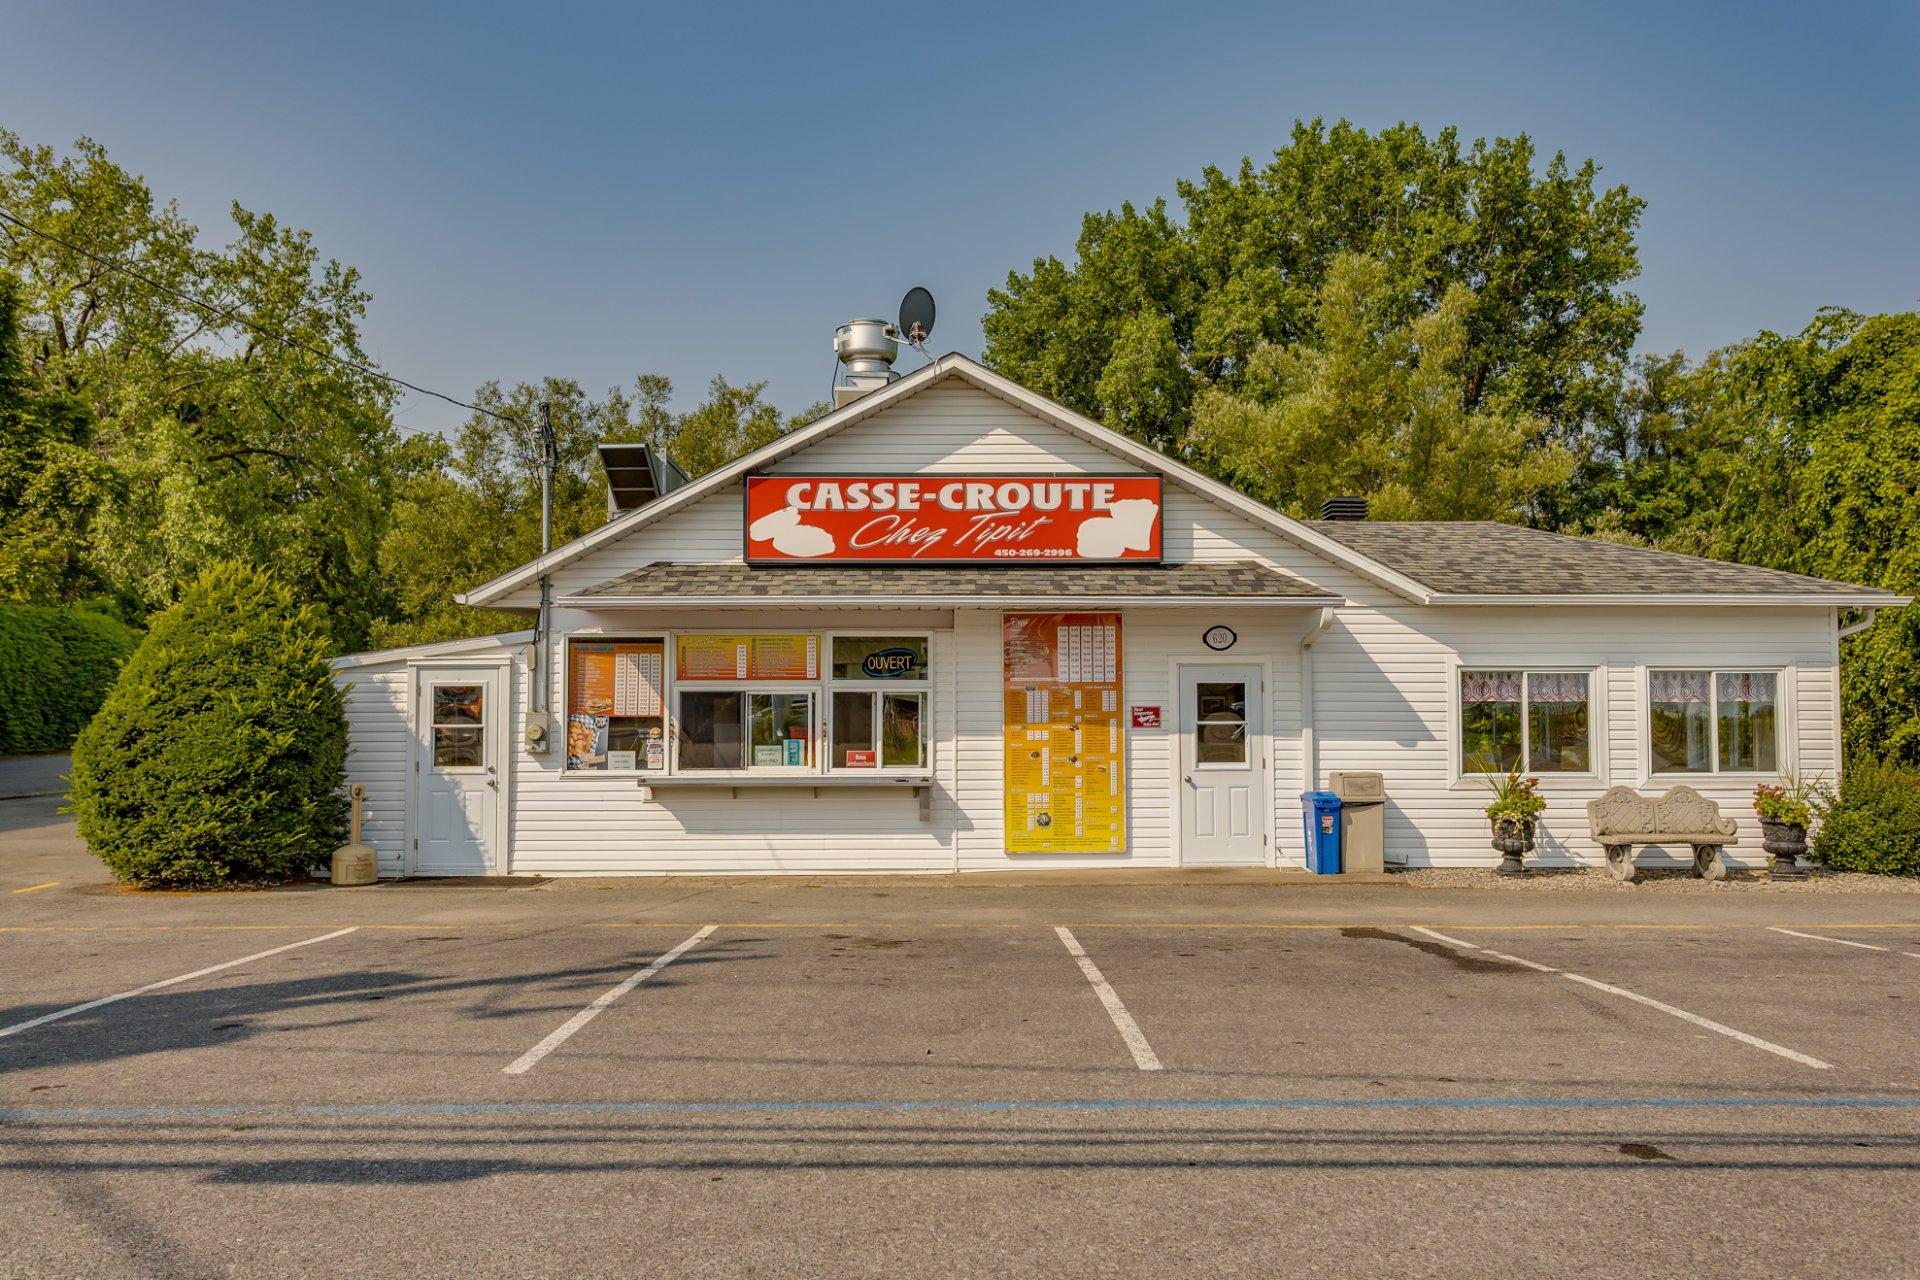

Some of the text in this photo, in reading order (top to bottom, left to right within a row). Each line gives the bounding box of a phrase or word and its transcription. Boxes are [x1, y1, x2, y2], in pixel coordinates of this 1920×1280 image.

[786, 482, 1115, 512] CASSE-CROUTE
[849, 510, 1053, 558] Chez Tipit
[994, 548, 1073, 557] 450-269-2996
[1212, 632, 1228, 644] 620
[867, 655, 912, 670] OUVERT
